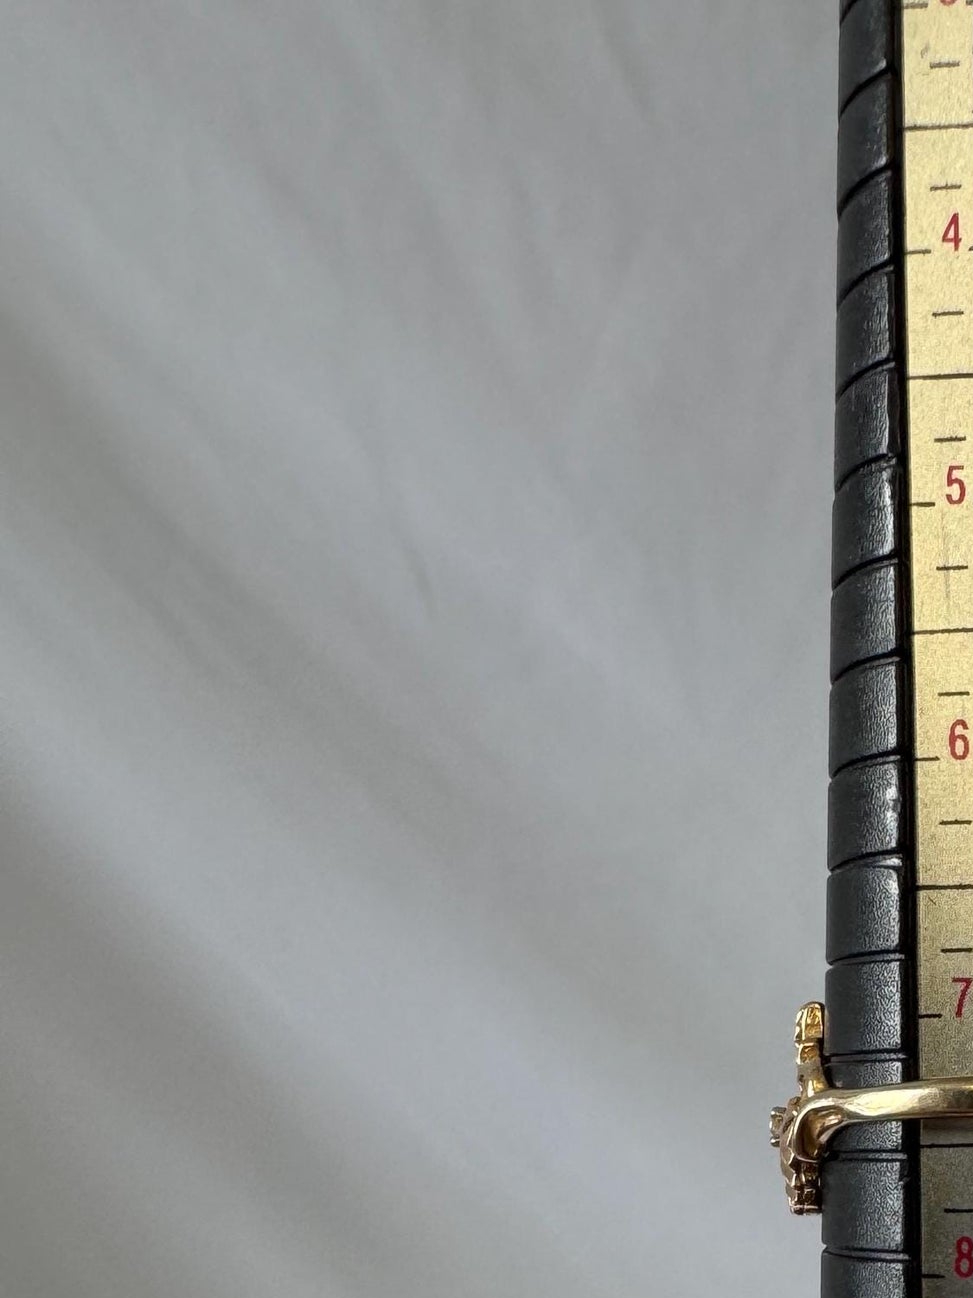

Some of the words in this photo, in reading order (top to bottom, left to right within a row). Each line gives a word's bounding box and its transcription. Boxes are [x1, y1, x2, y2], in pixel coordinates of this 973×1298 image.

[941, 212, 962, 252] 4
[945, 465, 967, 505] 5
[949, 718, 970, 761] 6
[952, 977, 973, 1019] 7
